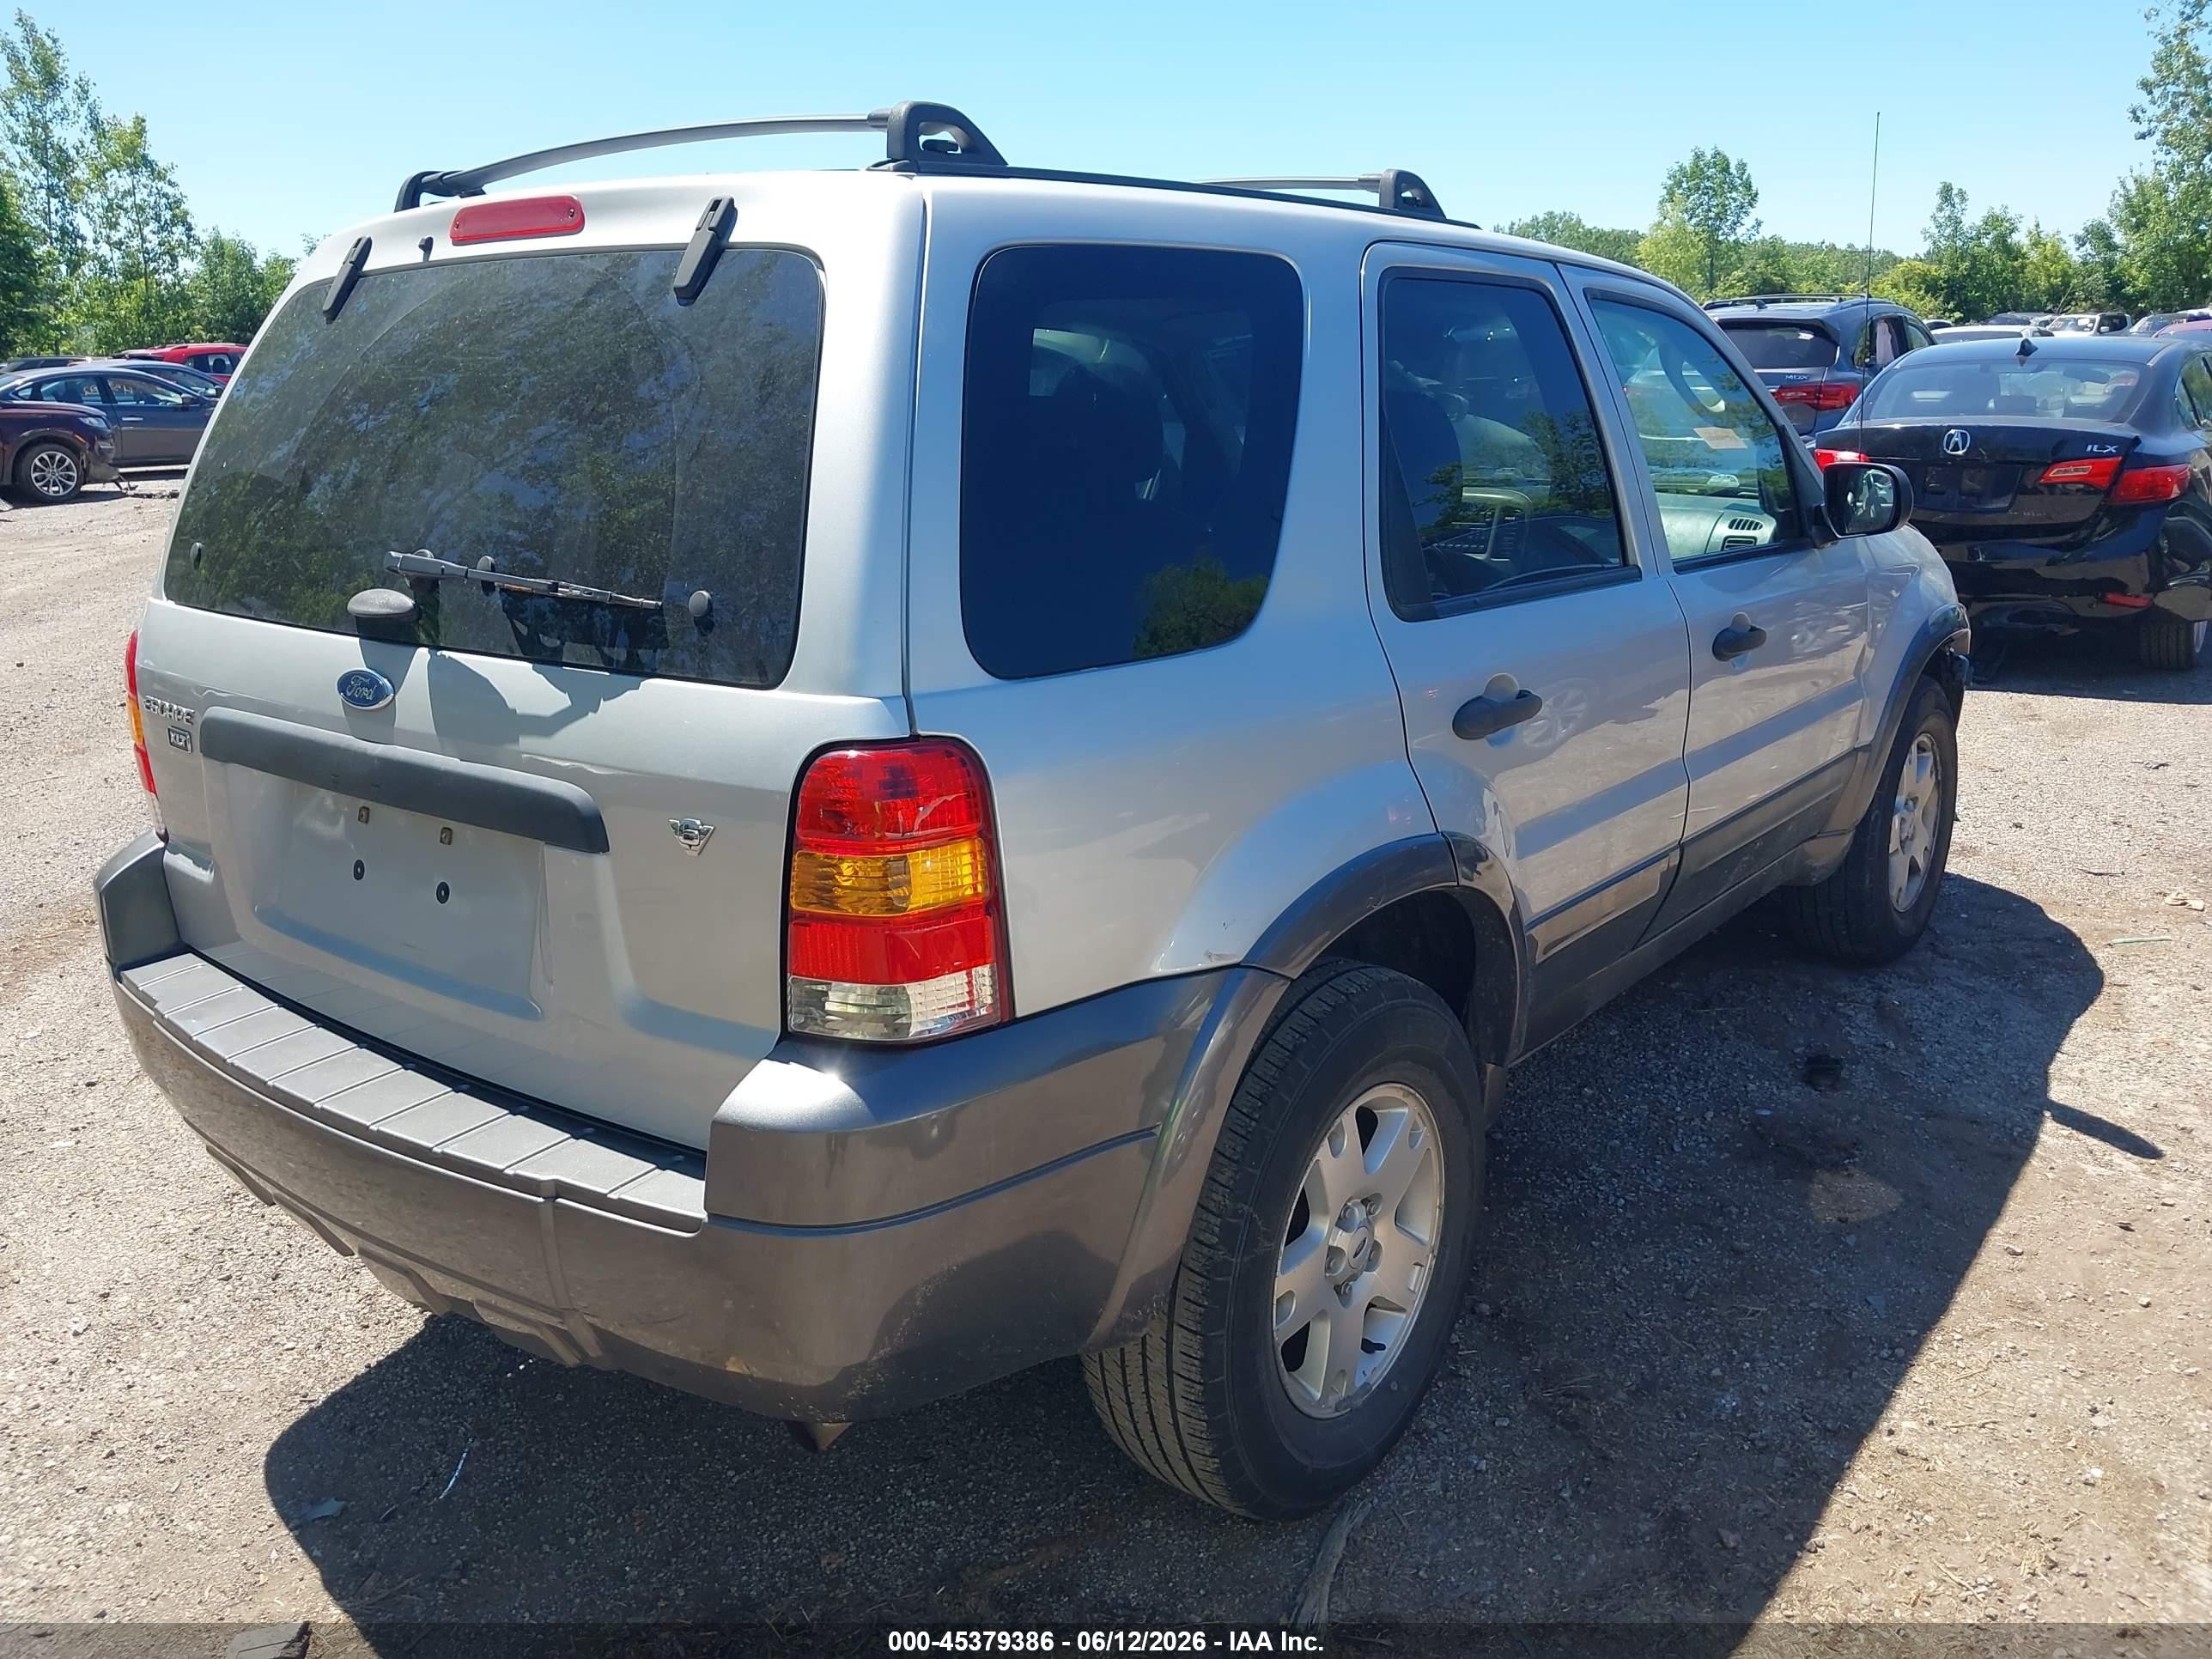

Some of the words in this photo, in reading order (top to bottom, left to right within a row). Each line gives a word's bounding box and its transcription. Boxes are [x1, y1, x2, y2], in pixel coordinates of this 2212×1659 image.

[2086, 444, 2119, 453] ILX
[143, 695, 195, 726] ESCAPE
[169, 728, 190, 751] XLT
